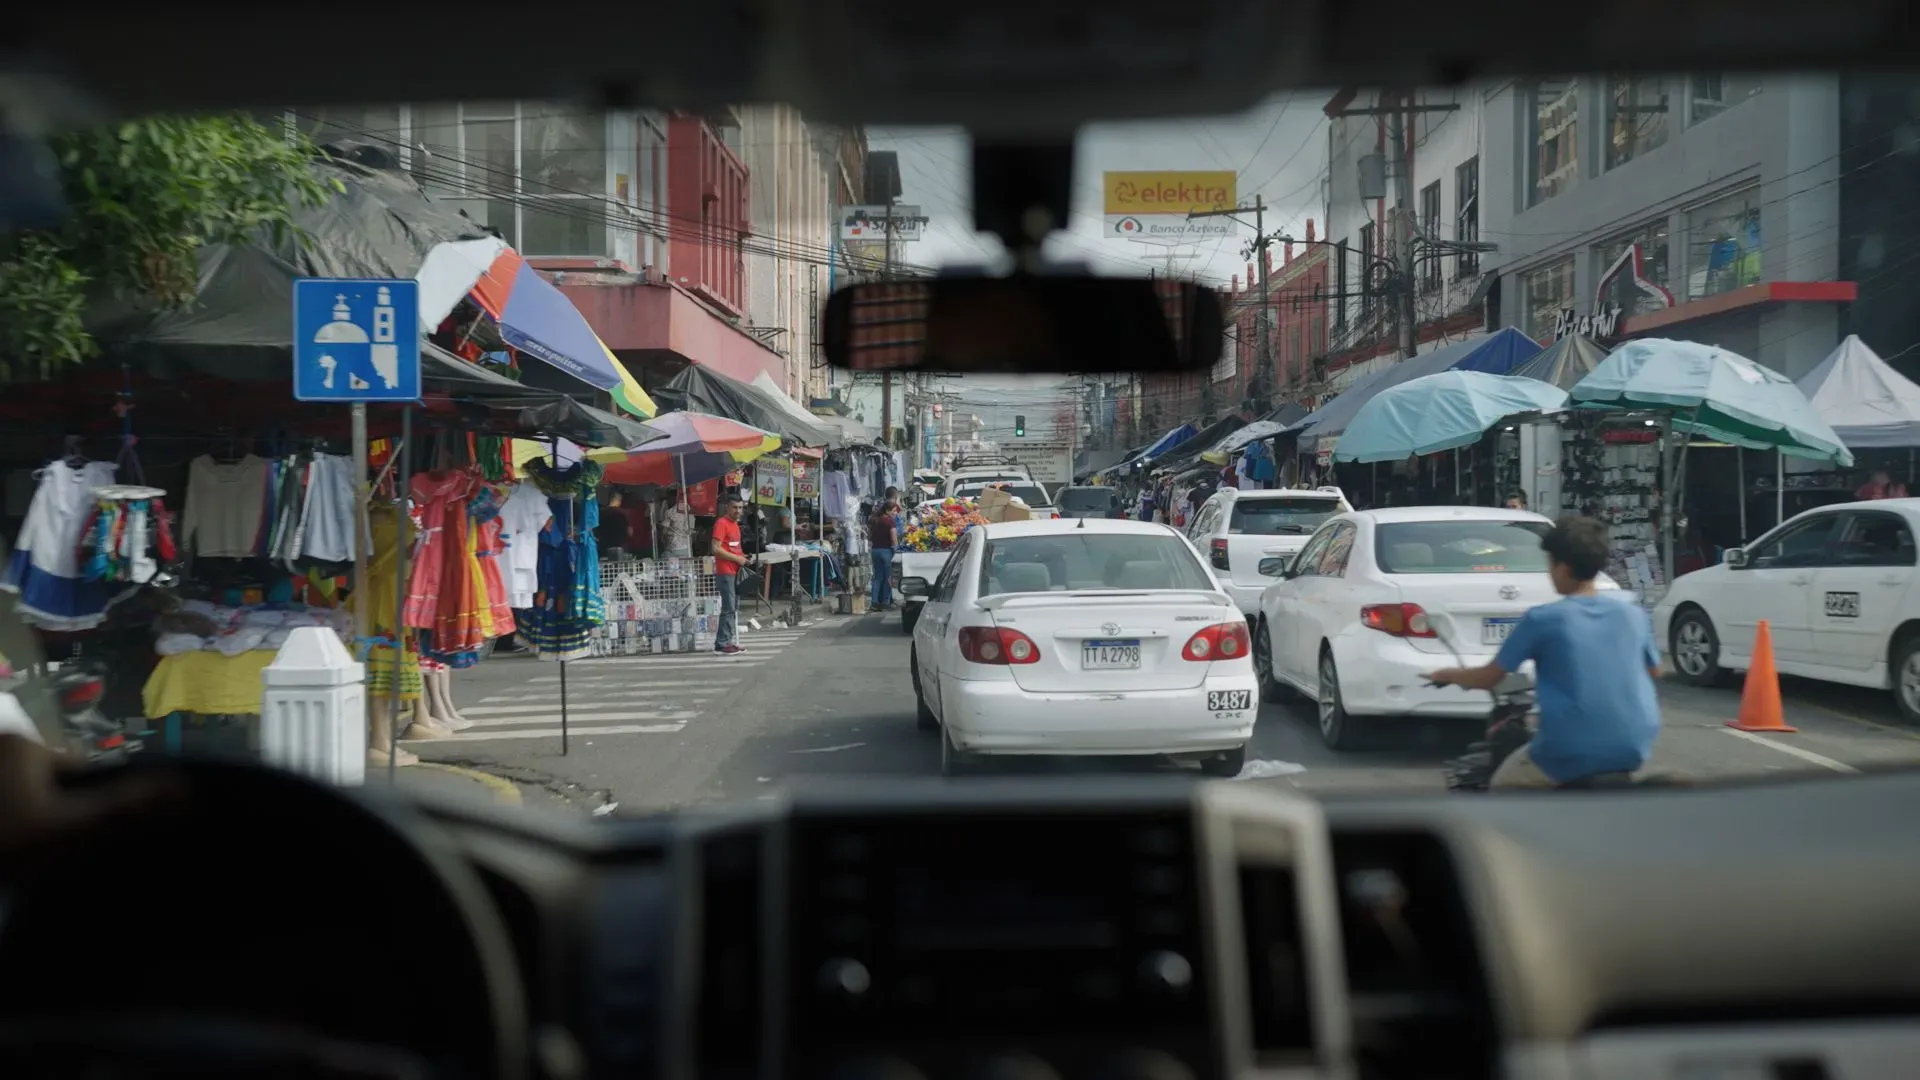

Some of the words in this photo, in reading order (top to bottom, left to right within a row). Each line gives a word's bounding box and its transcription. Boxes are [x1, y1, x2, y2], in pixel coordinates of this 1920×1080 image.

[1140, 182, 1228, 204] elektra
[1149, 224, 1184, 234] Banco
[1187, 224, 1227, 234] Azteca
[1209, 691, 1249, 710] 3487
